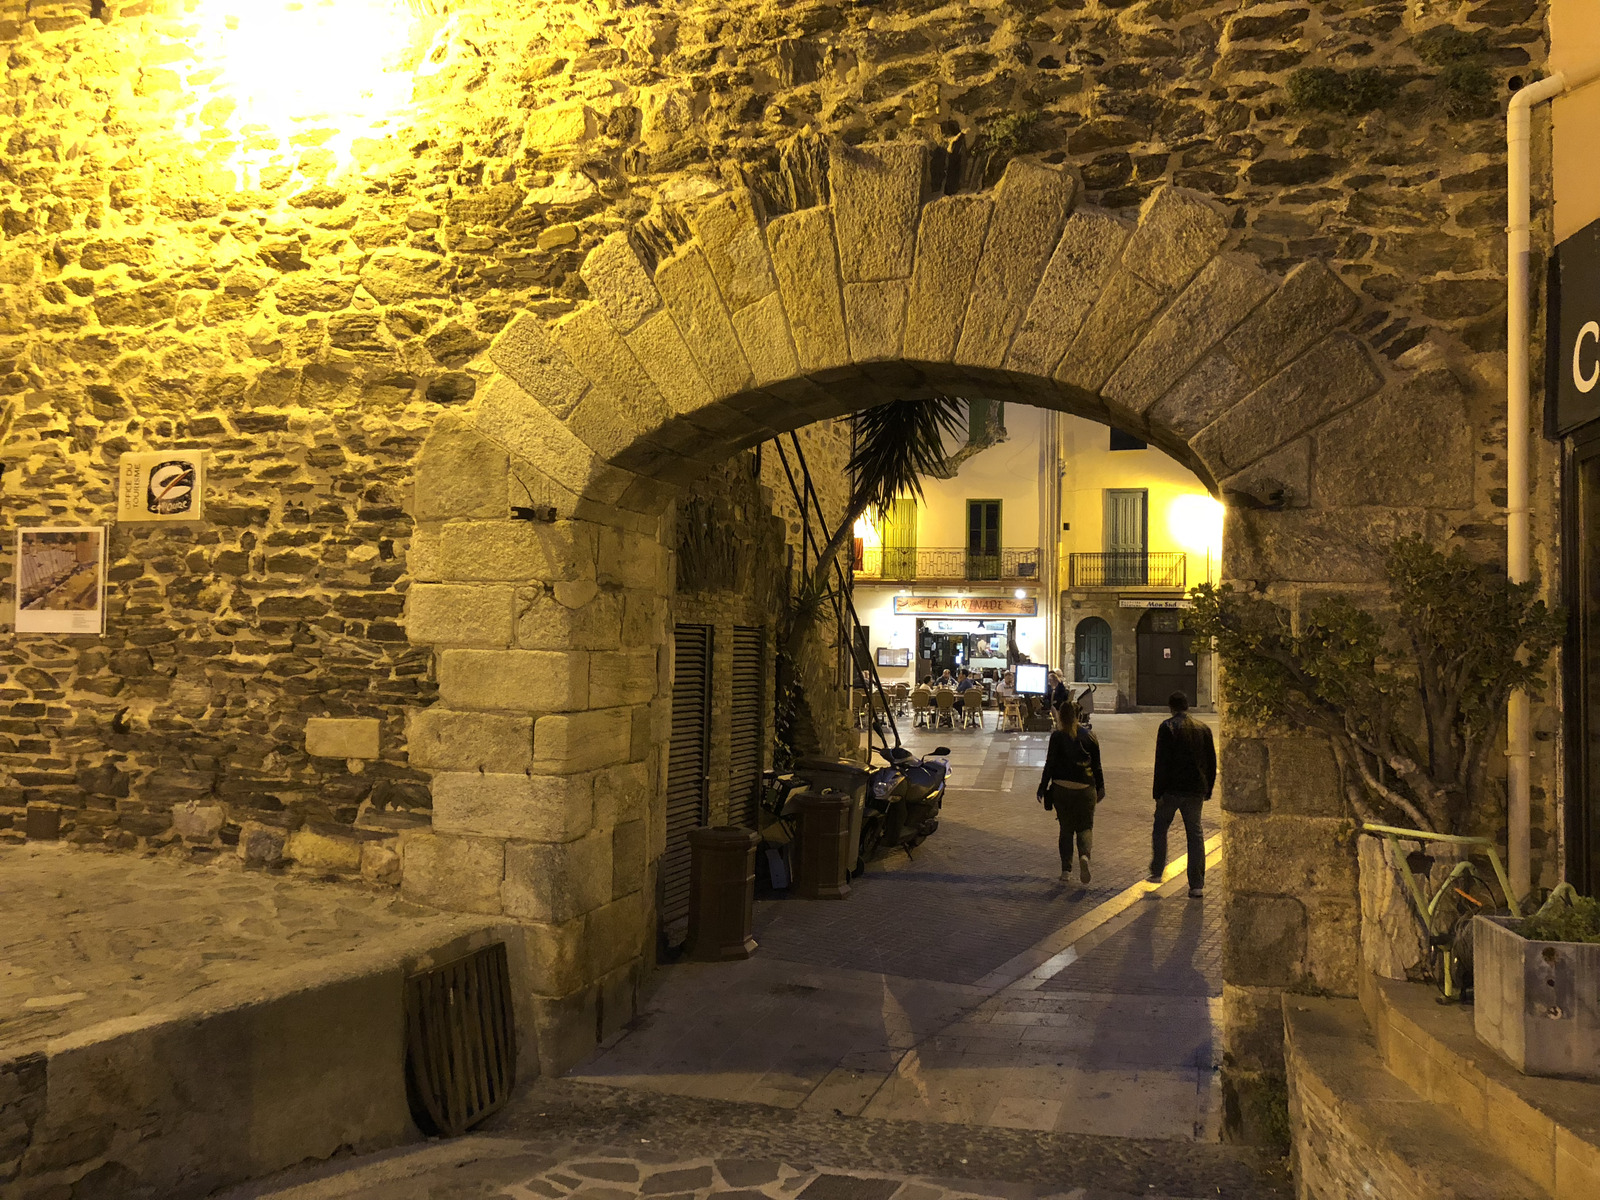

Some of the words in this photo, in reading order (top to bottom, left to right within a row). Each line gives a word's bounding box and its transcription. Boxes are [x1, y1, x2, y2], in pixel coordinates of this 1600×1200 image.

[126, 463, 133, 477] DU
[133, 463, 141, 508] TOURISME
[926, 598, 939, 609] LA
[944, 599, 1004, 611] MARINADE
